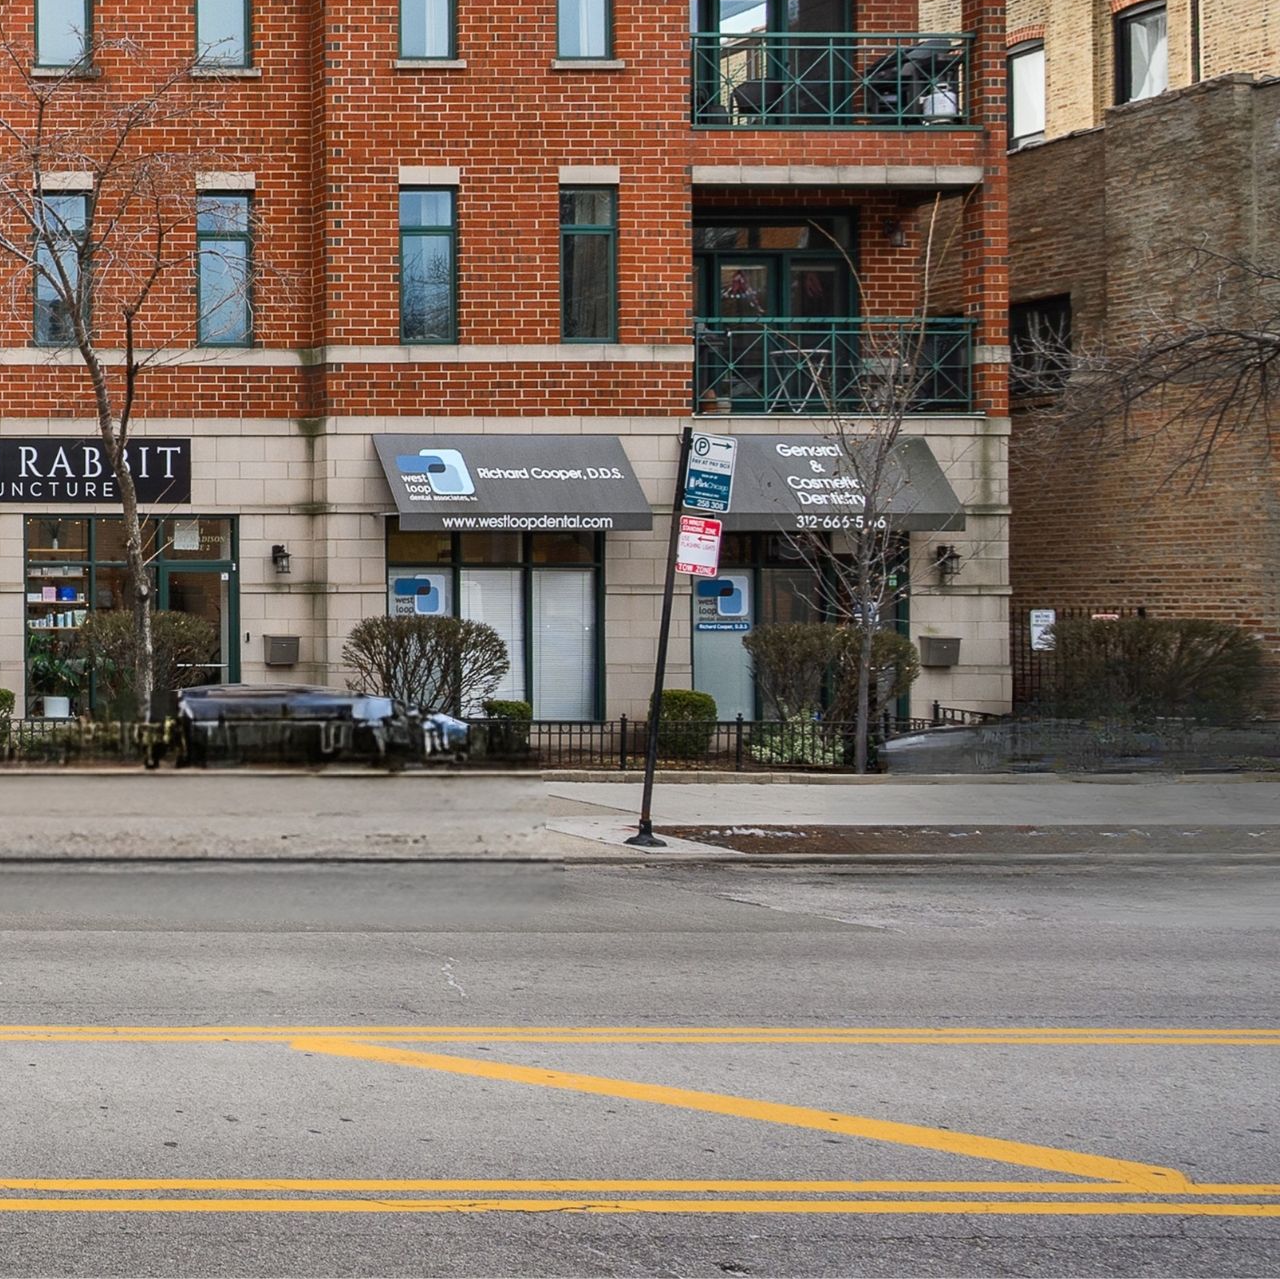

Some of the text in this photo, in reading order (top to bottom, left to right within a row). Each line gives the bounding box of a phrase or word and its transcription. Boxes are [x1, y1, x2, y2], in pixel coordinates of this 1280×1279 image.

[776, 443, 843, 457] General
[809, 460, 826, 473] &
[401, 473, 429, 483] west
[477, 467, 624, 481] Richard Cooper, D.D.S.
[405, 483, 432, 495] loop
[797, 491, 867, 507] Dentistry
[442, 515, 613, 530] www.westloopdental.com
[796, 515, 886, 529] 312-666-56
